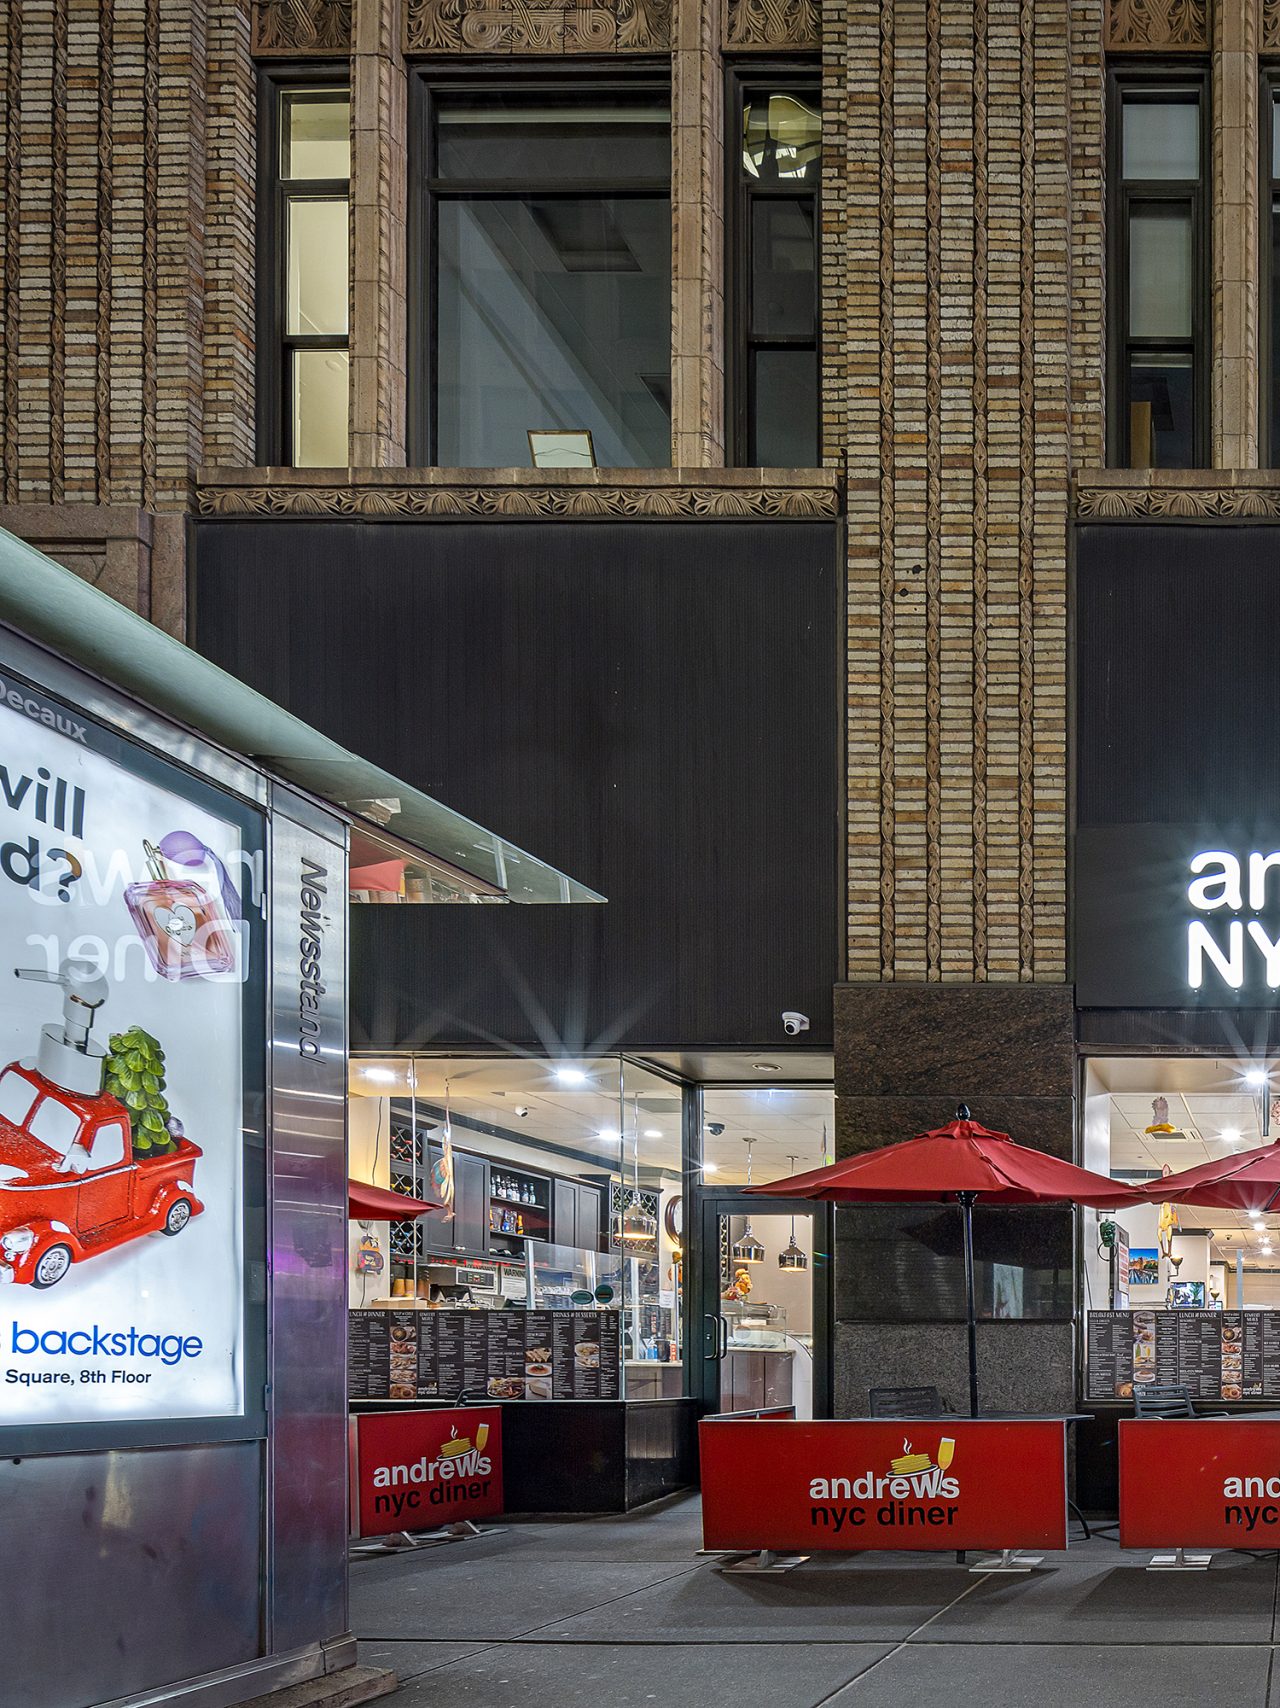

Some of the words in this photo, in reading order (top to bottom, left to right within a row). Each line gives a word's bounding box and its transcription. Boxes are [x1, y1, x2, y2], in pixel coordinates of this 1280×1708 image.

[300, 856, 328, 1064] Newsstand
[11, 1321, 203, 1366] backstage
[5, 1369, 75, 1387] Square,
[79, 1370, 106, 1384] 8th
[111, 1370, 152, 1384] Floor
[375, 1488, 421, 1518] nyc
[429, 1480, 491, 1505] diner
[811, 1506, 866, 1533] nyc
[877, 1501, 959, 1526] diner
[1225, 1505, 1279, 1532] nyc
